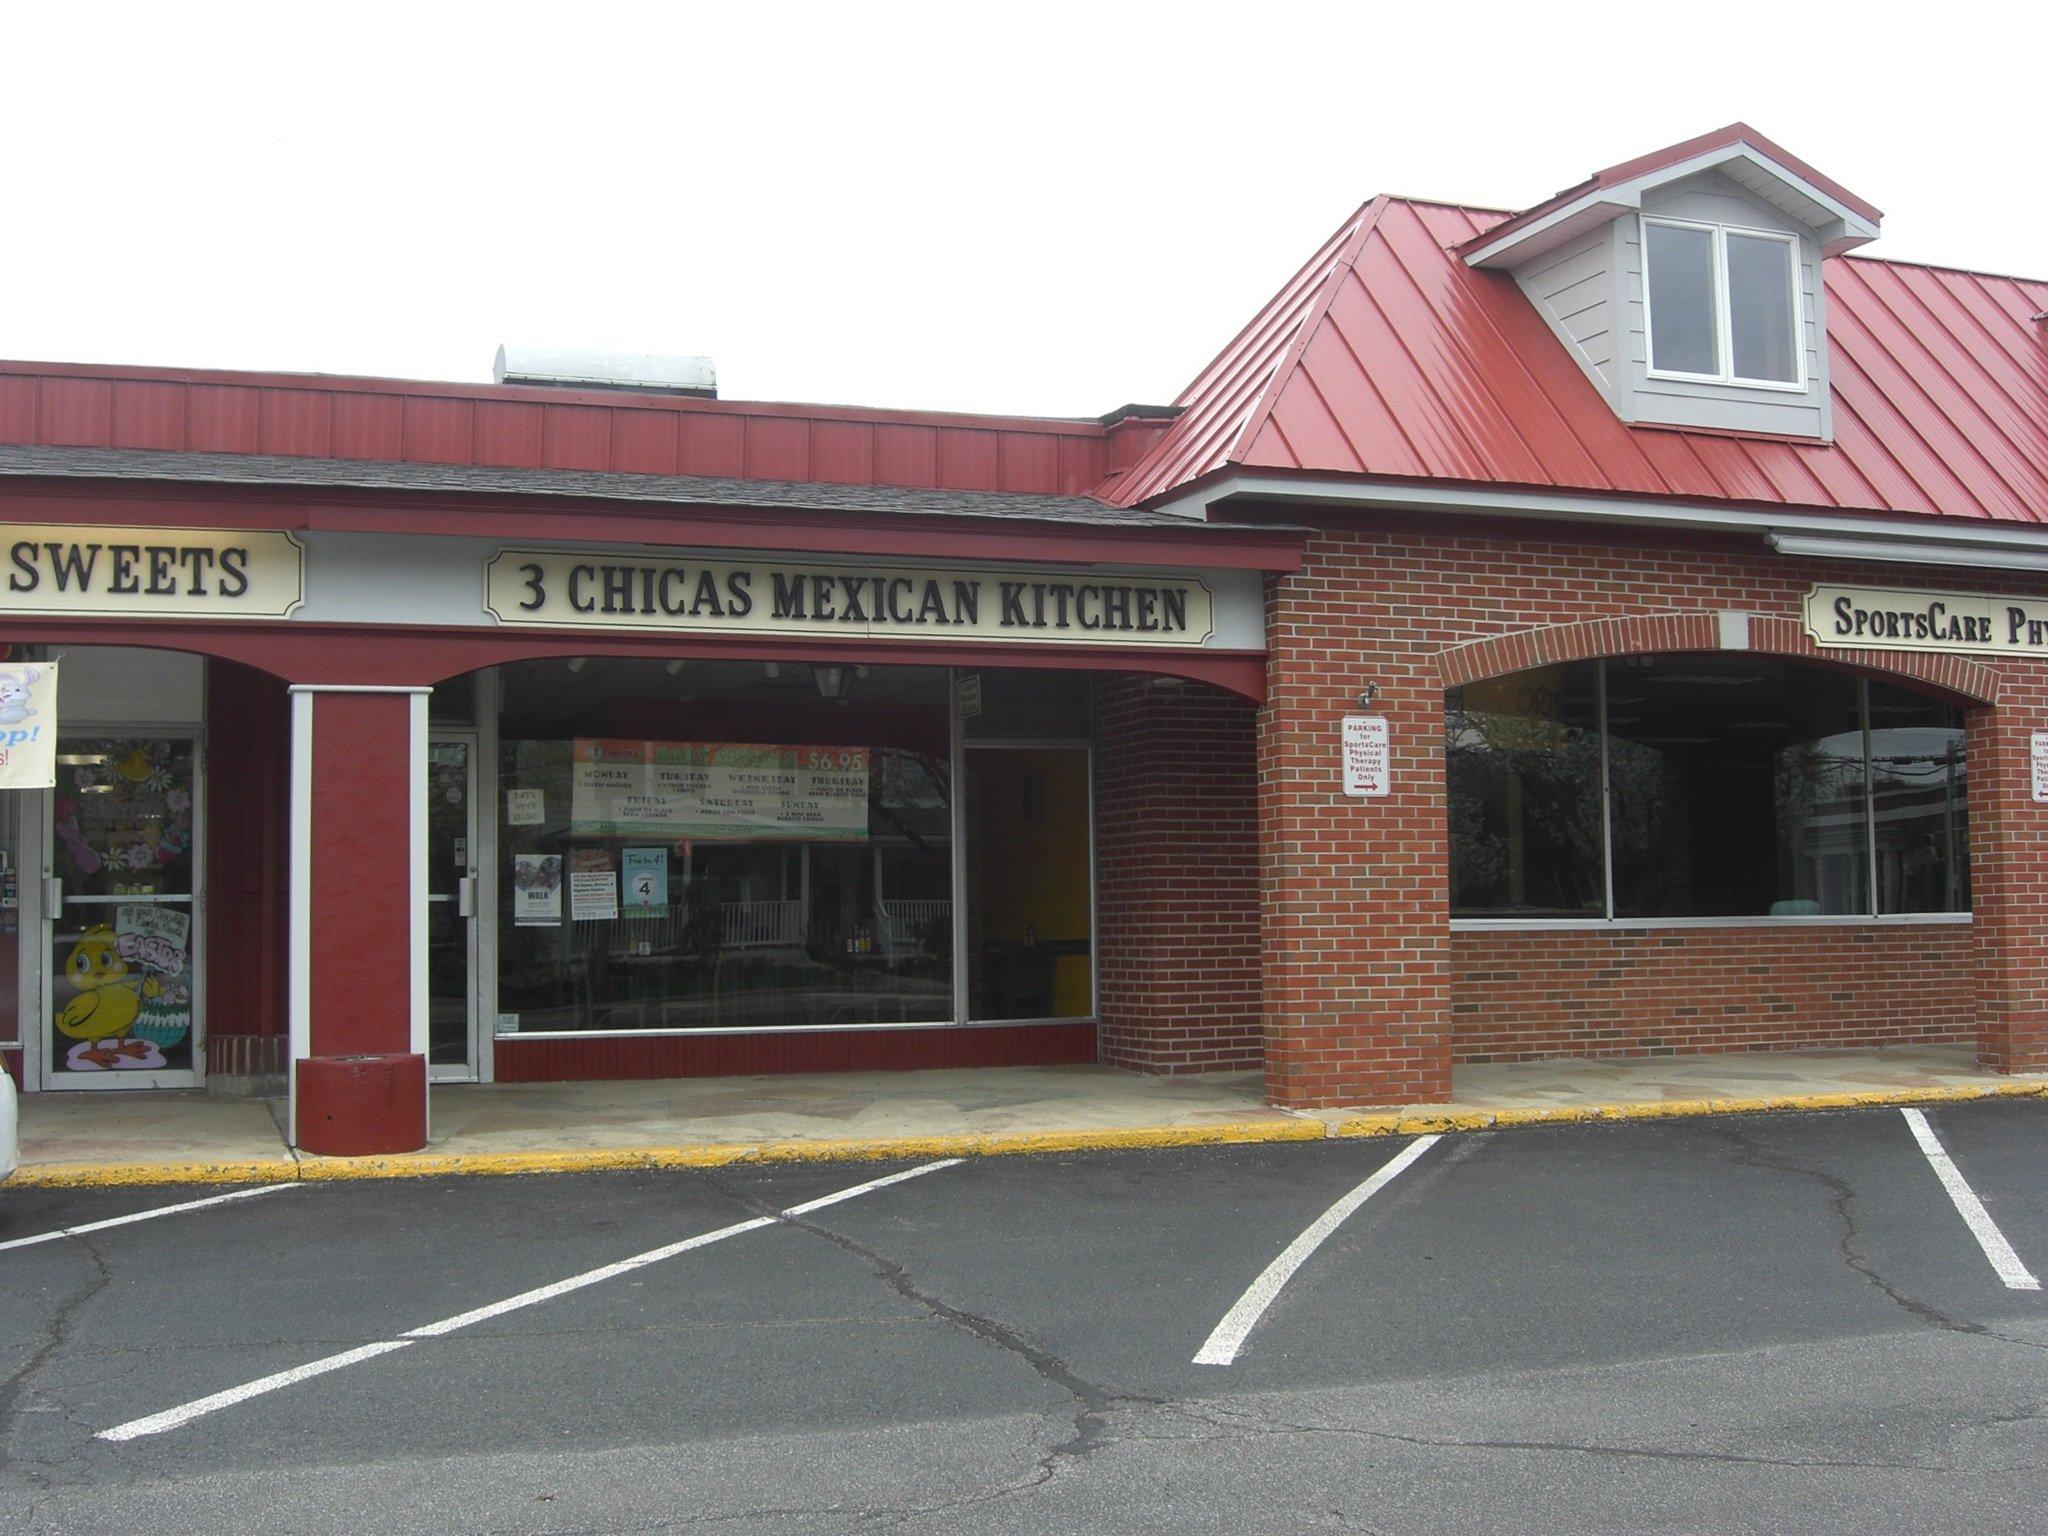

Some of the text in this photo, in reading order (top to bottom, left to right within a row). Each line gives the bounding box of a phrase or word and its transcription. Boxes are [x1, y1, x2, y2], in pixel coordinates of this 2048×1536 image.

[9, 541, 249, 597] SWEETS
[519, 564, 1189, 632] 3 CHICAS MEXICAN KITCHEN
[1344, 741, 1387, 749] SportsCare
[1349, 749, 1382, 757] Physical
[808, 749, 862, 771] $6.95
[583, 769, 628, 779] MONDAY
[660, 772, 710, 781] TUESDAY
[1357, 774, 1375, 782] Only
[728, 774, 797, 784] WEDNESDAY
[811, 776, 864, 785] THURSDAY
[627, 795, 667, 804] FRIDAY
[699, 799, 754, 807] SATURDAY
[780, 800, 820, 809] SUNDAY
[639, 882, 651, 895] 4
[527, 891, 549, 900] WALK
